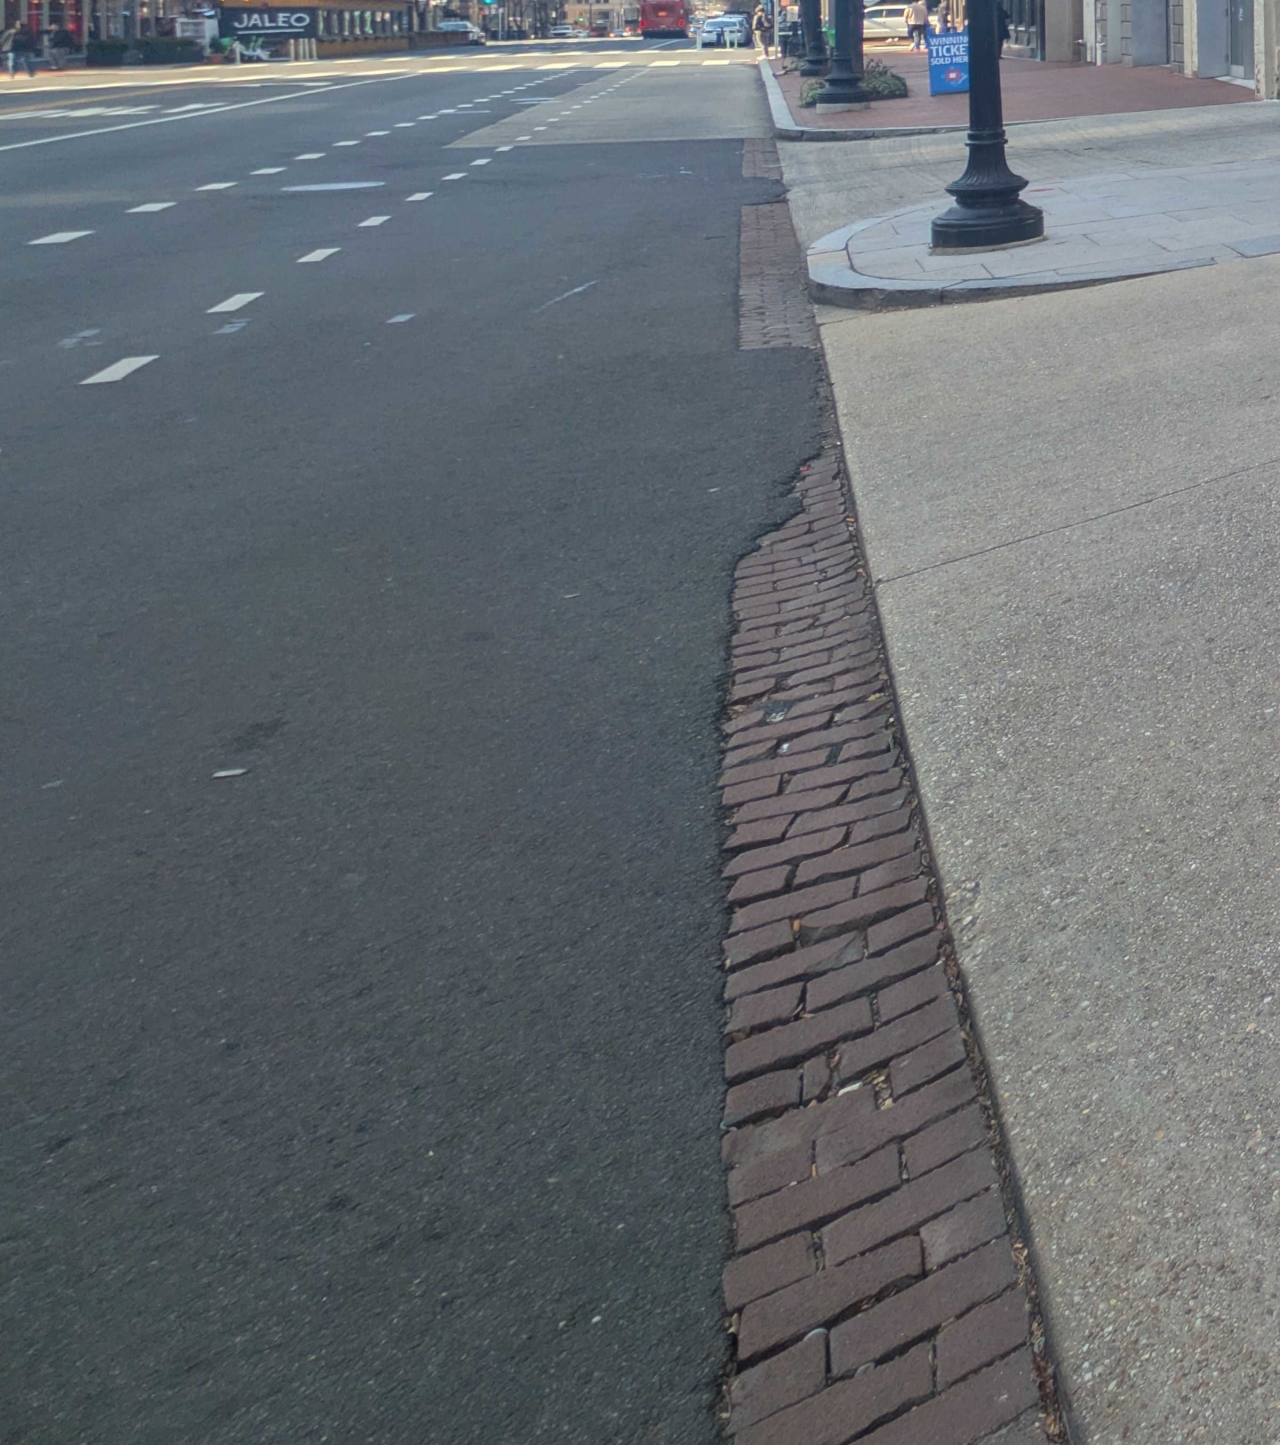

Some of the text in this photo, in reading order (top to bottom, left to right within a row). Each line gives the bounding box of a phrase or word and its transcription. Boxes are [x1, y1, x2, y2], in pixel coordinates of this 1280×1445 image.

[233, 13, 311, 29] JALEO
[929, 36, 968, 46] WINNIN
[929, 43, 968, 57] TICKE
[930, 57, 951, 66] SOLD
